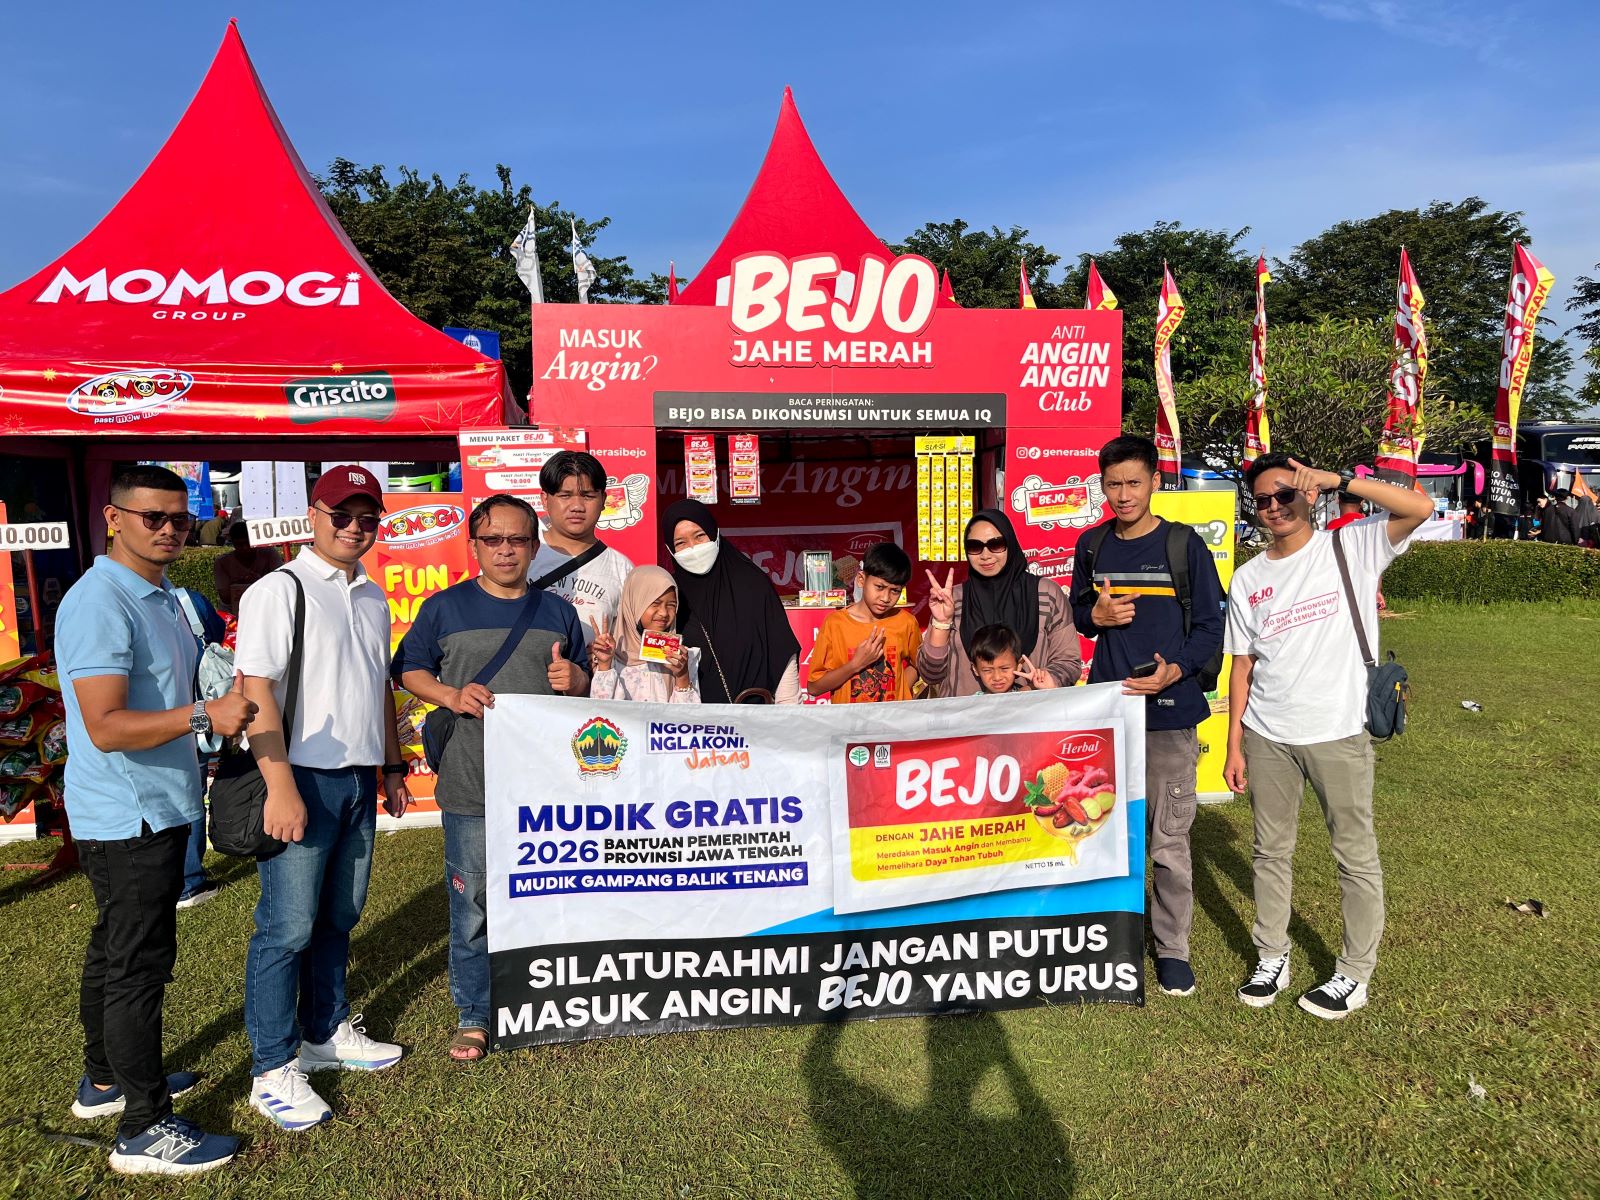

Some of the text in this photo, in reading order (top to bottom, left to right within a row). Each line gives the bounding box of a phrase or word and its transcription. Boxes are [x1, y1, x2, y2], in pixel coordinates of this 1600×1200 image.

[731, 255, 935, 334] BEJO
[152, 310, 246, 321] GROUP
[559, 329, 643, 348] MASUK
[1051, 325, 1085, 339] ANTI
[1510, 284, 1548, 395] JAHE MERAH
[732, 340, 932, 363] JAHE MERAH
[1020, 343, 1110, 364] ANGIN
[540, 350, 658, 391] Angin?
[1020, 366, 1110, 387] ANGIN
[294, 380, 388, 408] Criscito
[1038, 391, 1091, 412] Club
[94, 417, 115, 425] pasti
[668, 408, 992, 422] BEJO BISA DIKONSUMSI UNTUK SEMUA IQ
[524, 433, 544, 441] BEJO
[589, 448, 647, 458] nerasibejo
[1043, 448, 1100, 458] generasibe
[1039, 493, 1065, 505] BEJO
[385, 563, 448, 592] FUN
[571, 578, 605, 599] YOUTH
[1248, 586, 1273, 607] BEJO
[1294, 611, 1317, 622] SEMUA
[650, 722, 739, 735] NGOPENI.
[651, 736, 749, 750] NGLAKONI.
[1060, 740, 1100, 755] Herbal
[1198, 744, 1209, 753] id
[685, 749, 750, 769] Jateng
[895, 755, 1021, 810] BEJO
[518, 796, 803, 833] MUDIK GRATIS
[604, 831, 791, 850] BANTUAN PEMERINTAH
[875, 819, 1025, 842] DENGAN JAHE MERAH
[517, 840, 599, 866] 2026
[604, 845, 803, 864] PROVINSI JAWA TENGAH
[876, 837, 1031, 859] Meredakan Masuk Angin dan Membantu
[877, 850, 1003, 871] Memelihara Daya Tahan Tubuh
[1025, 862, 1046, 870] NETTO
[515, 868, 803, 892] MUDIK GAMPANG BALIK TENANG
[528, 924, 1108, 989] SILATURAHMI JANGAN PUTUS
[498, 962, 1138, 1038] MASUK ANGIN, BEJO YANG URUS
